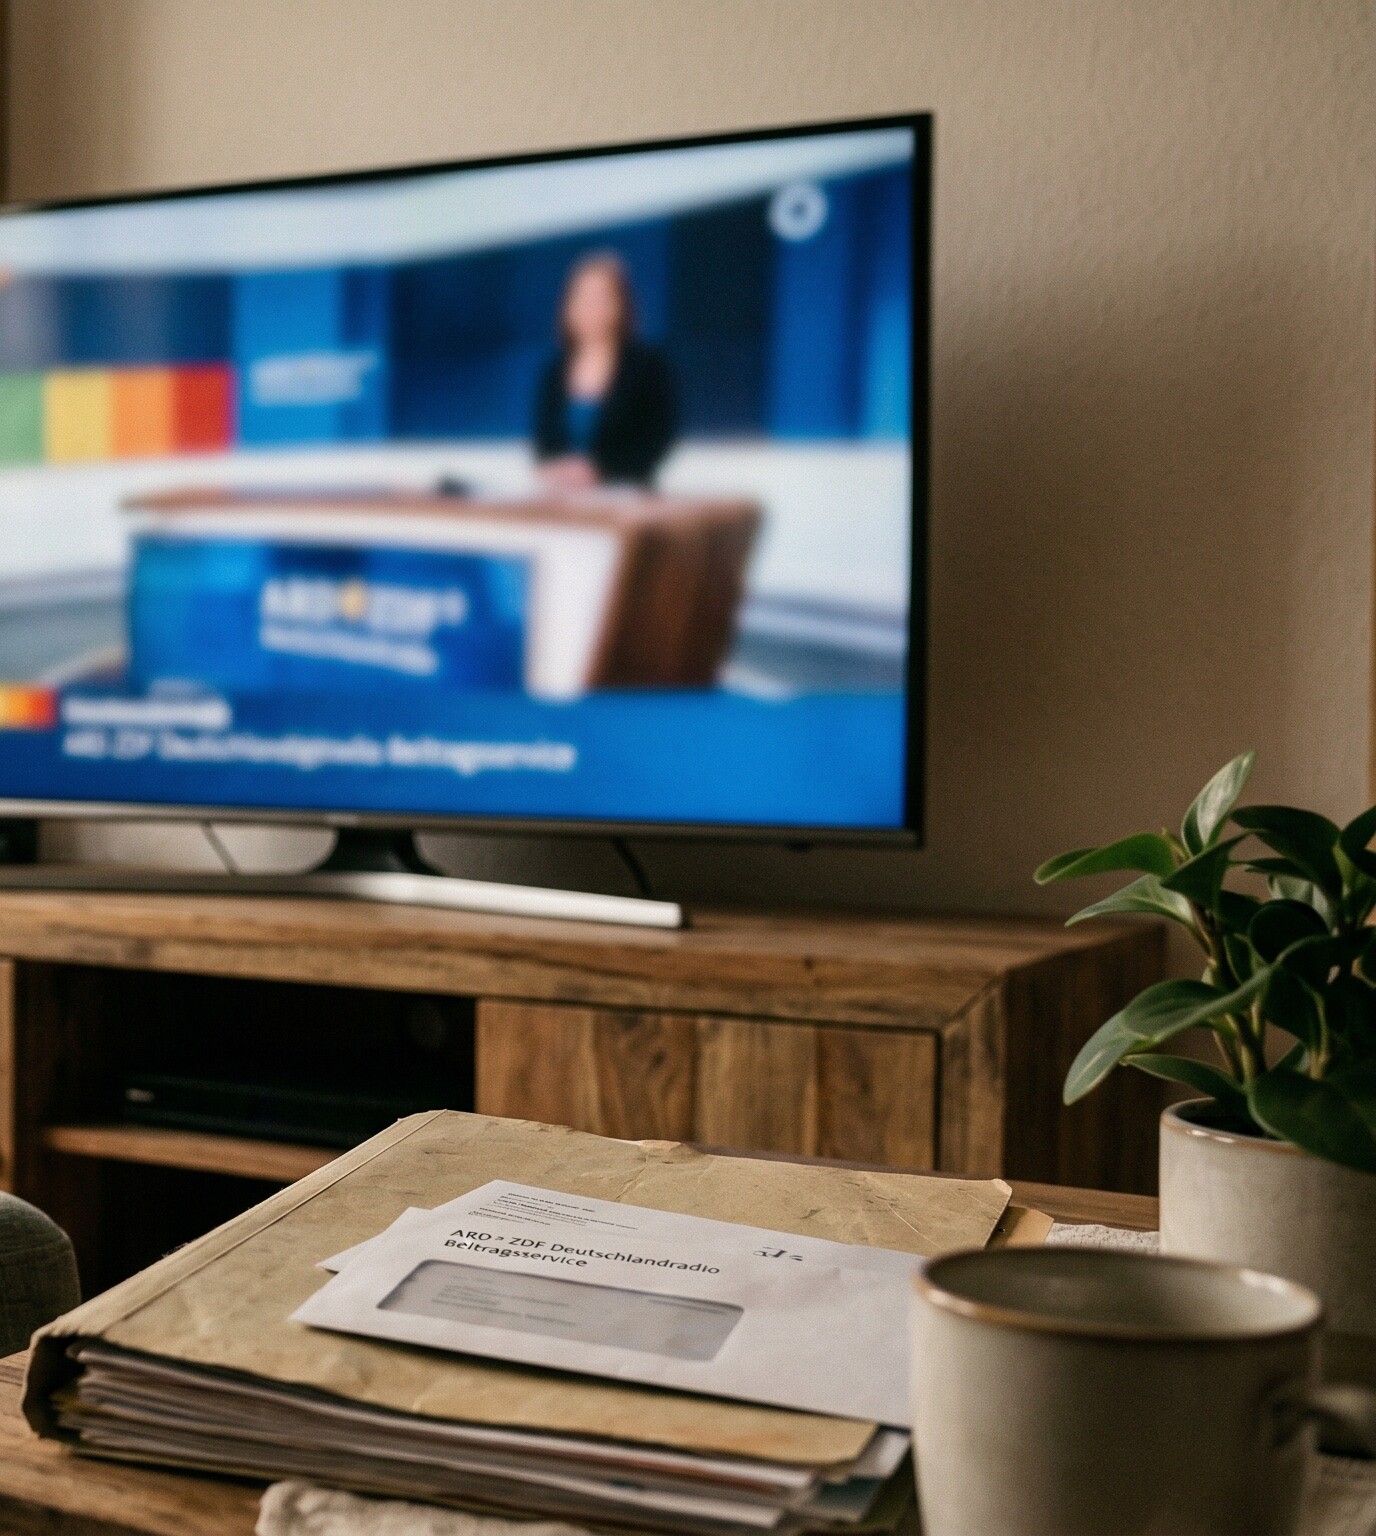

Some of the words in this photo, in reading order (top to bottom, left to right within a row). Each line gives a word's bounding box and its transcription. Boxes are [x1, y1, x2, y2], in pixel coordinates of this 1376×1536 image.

[450, 1229, 492, 1241] ARD
[509, 1237, 546, 1249] ZDF
[550, 1243, 721, 1274] Deutschlandradio
